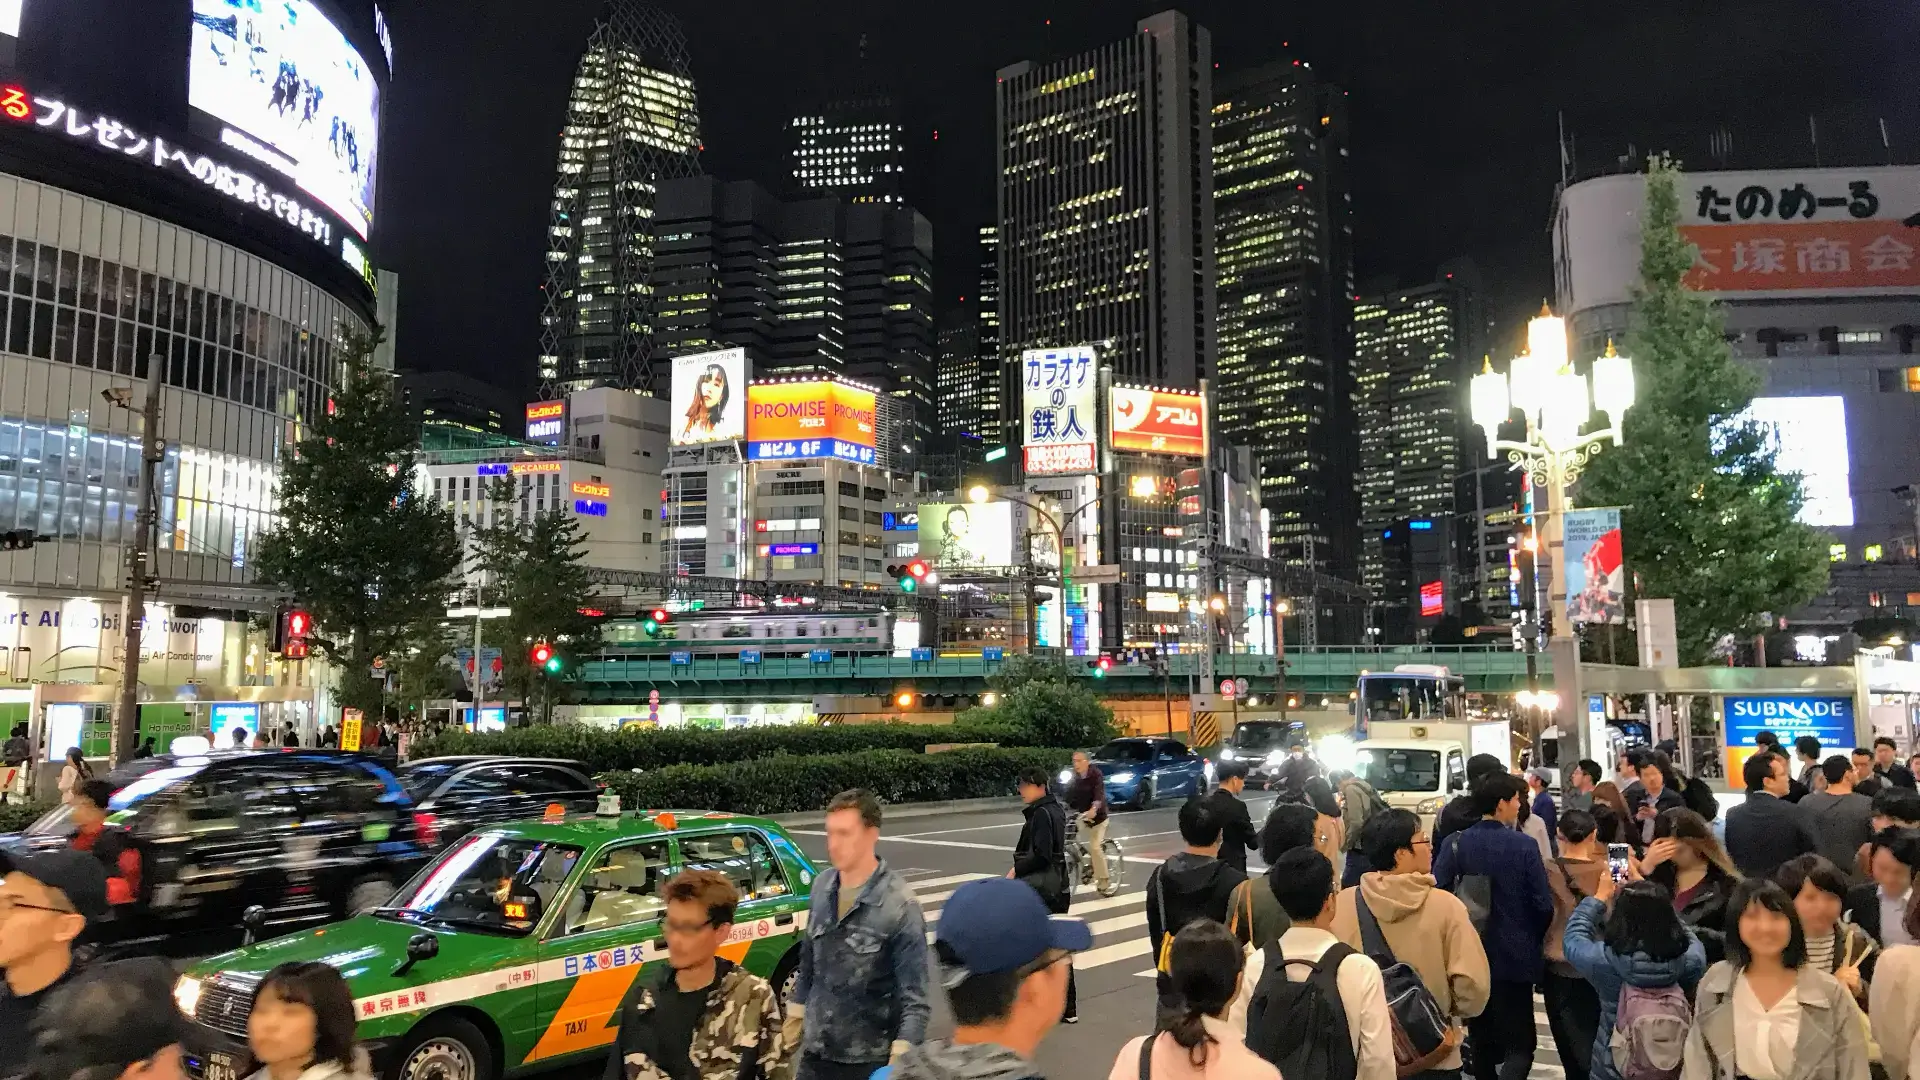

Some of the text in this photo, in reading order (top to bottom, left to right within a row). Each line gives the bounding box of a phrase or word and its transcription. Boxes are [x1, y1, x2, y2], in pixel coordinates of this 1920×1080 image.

[1696, 181, 1879, 222] たのめーる
[1026, 352, 1091, 389] カラオケ
[1052, 388, 1066, 407] の
[754, 401, 826, 419] PROMISE
[834, 403, 872, 425] PROMISE
[1156, 406, 1199, 426] アコム
[1032, 407, 1085, 440] 鉄人
[801, 441, 821, 455] 6F
[527, 463, 561, 472] CAMERA
[1567, 518, 1596, 527] RUGBY
[1567, 526, 1598, 534] WORLD
[1591, 533, 1617, 541] JAP
[1, 611, 29, 626] rt
[38, 610, 60, 627] AI
[152, 650, 166, 660] Air
[1733, 701, 1844, 719] SUBNADE
[732, 927, 753, 940] 6194
[508, 969, 536, 985] (中野)
[362, 990, 427, 1017] 東京無線
[565, 1019, 588, 1036] TAXI
